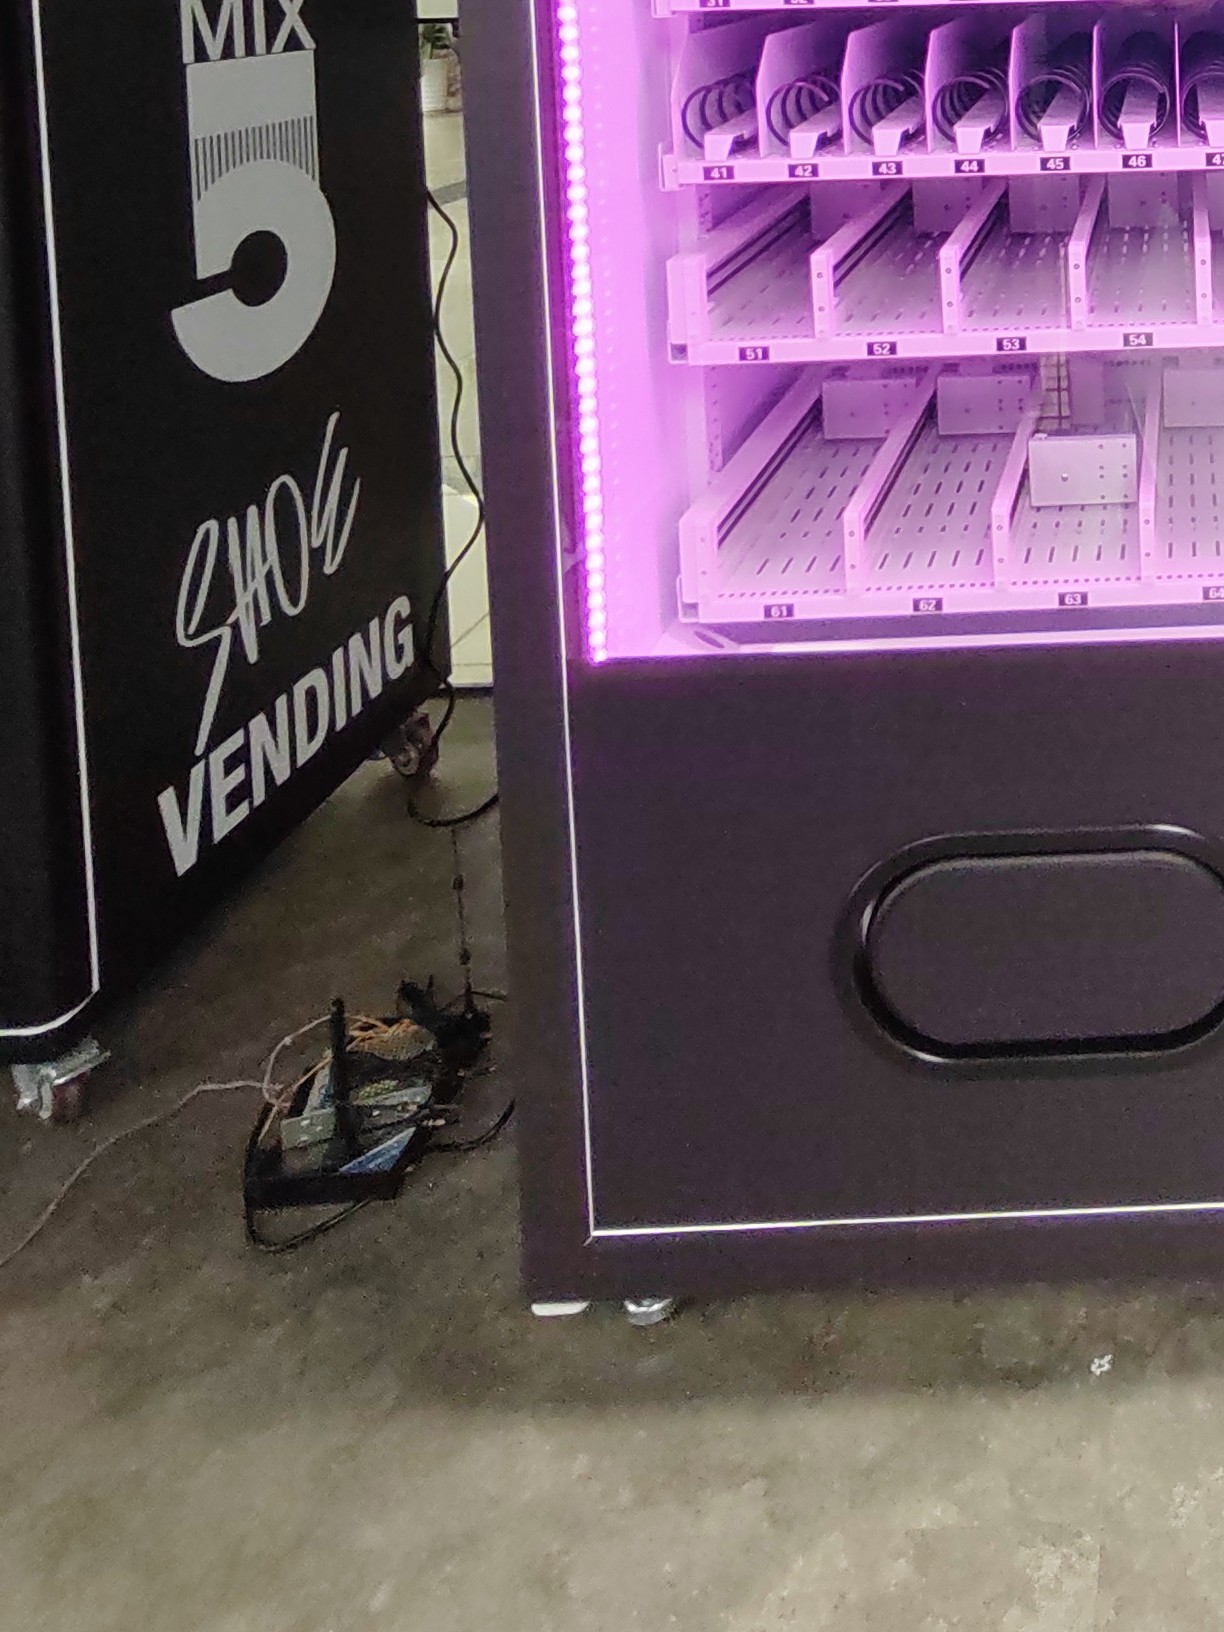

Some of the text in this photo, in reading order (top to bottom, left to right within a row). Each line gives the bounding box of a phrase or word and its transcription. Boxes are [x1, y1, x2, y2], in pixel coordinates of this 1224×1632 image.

[710, 167, 727, 179] 41
[795, 165, 812, 177] 42
[879, 162, 897, 174] 43
[960, 160, 979, 172] 44
[1046, 158, 1064, 169] 45
[1128, 155, 1146, 167] 46
[171, 50, 337, 382] 5
[745, 347, 763, 360] 51
[873, 342, 890, 355] 52
[1002, 338, 1020, 350] 53
[1129, 334, 1147, 346] 54
[771, 604, 787, 618] 61
[919, 599, 937, 611] 62
[1064, 592, 1082, 605] 63
[156, 596, 415, 876] VENDING
